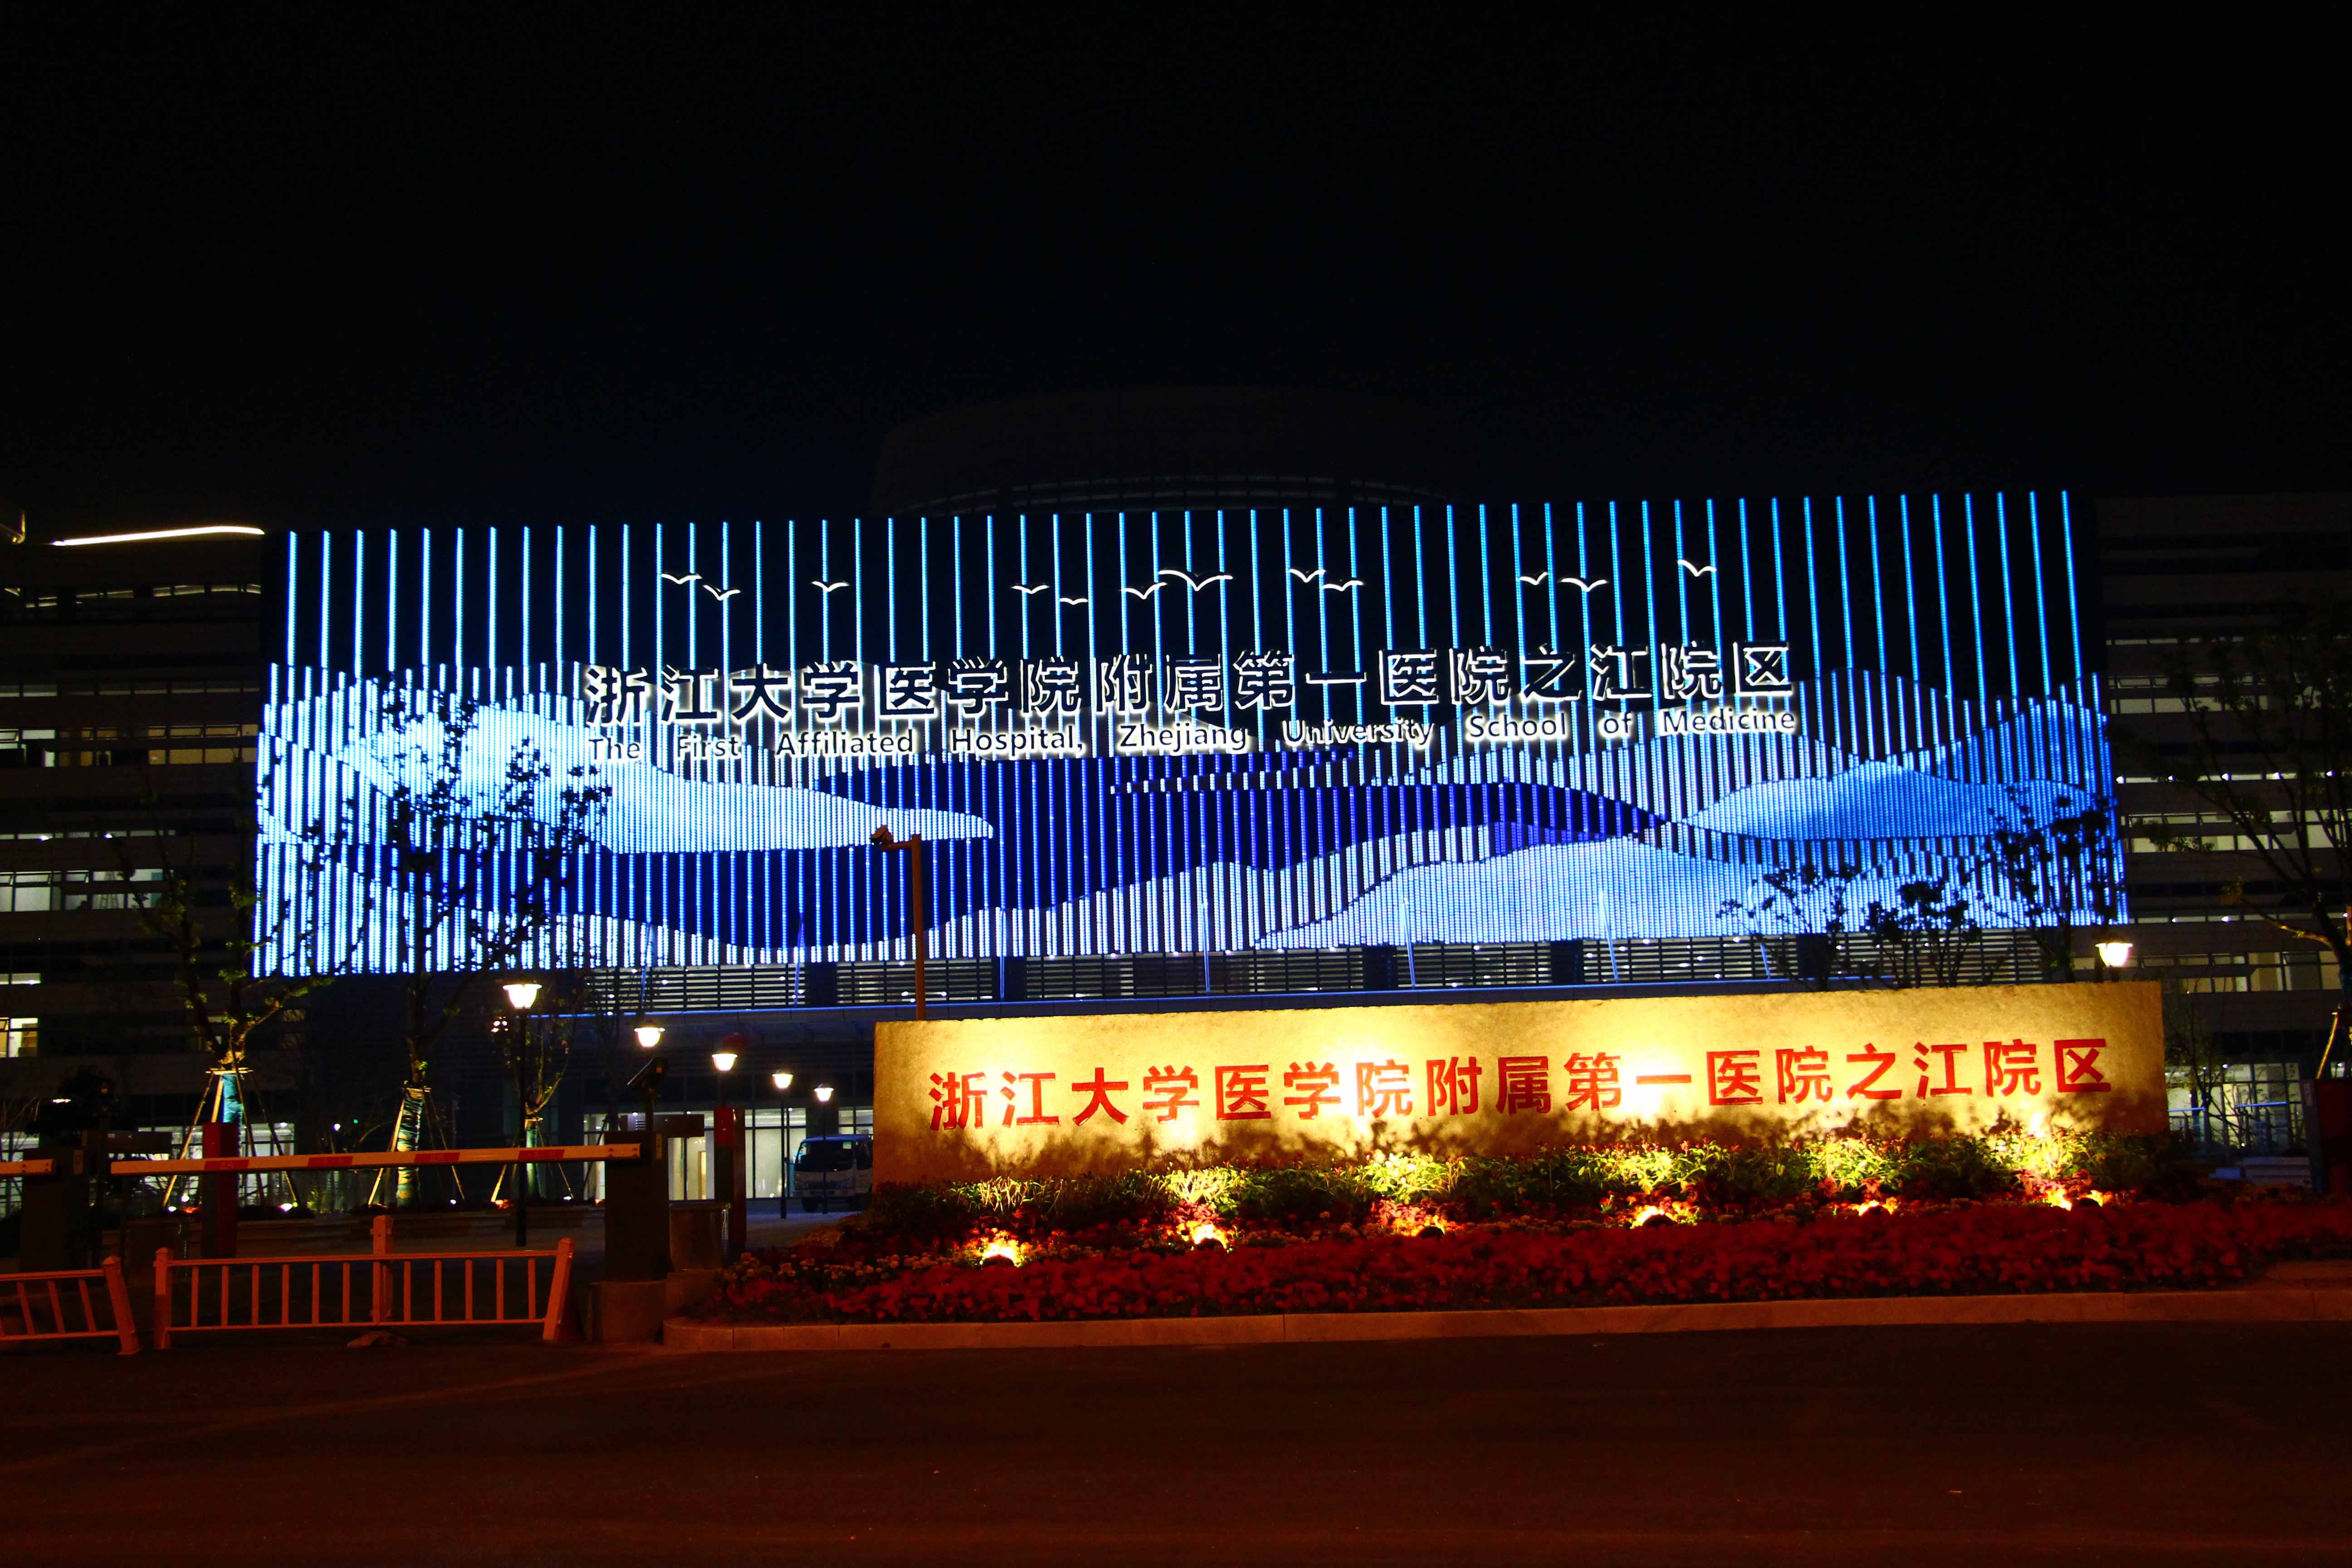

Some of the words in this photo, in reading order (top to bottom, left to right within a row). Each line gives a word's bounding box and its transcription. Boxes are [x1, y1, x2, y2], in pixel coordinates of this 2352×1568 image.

[585, 641, 1792, 725] 浙江大学医学院附属第一医院之江院区
[588, 738, 641, 759] The
[677, 734, 740, 757] First
[776, 729, 913, 755] Affiliated
[952, 725, 1083, 756] Hospital,
[1119, 724, 1247, 751] Zhejiang
[1283, 719, 1433, 748] University
[1470, 713, 1565, 739] School
[1602, 712, 1632, 734] of
[1664, 708, 1795, 733] Medicine
[929, 1038, 2112, 1132] 浙江大学医学院附属第一医院之江院区
